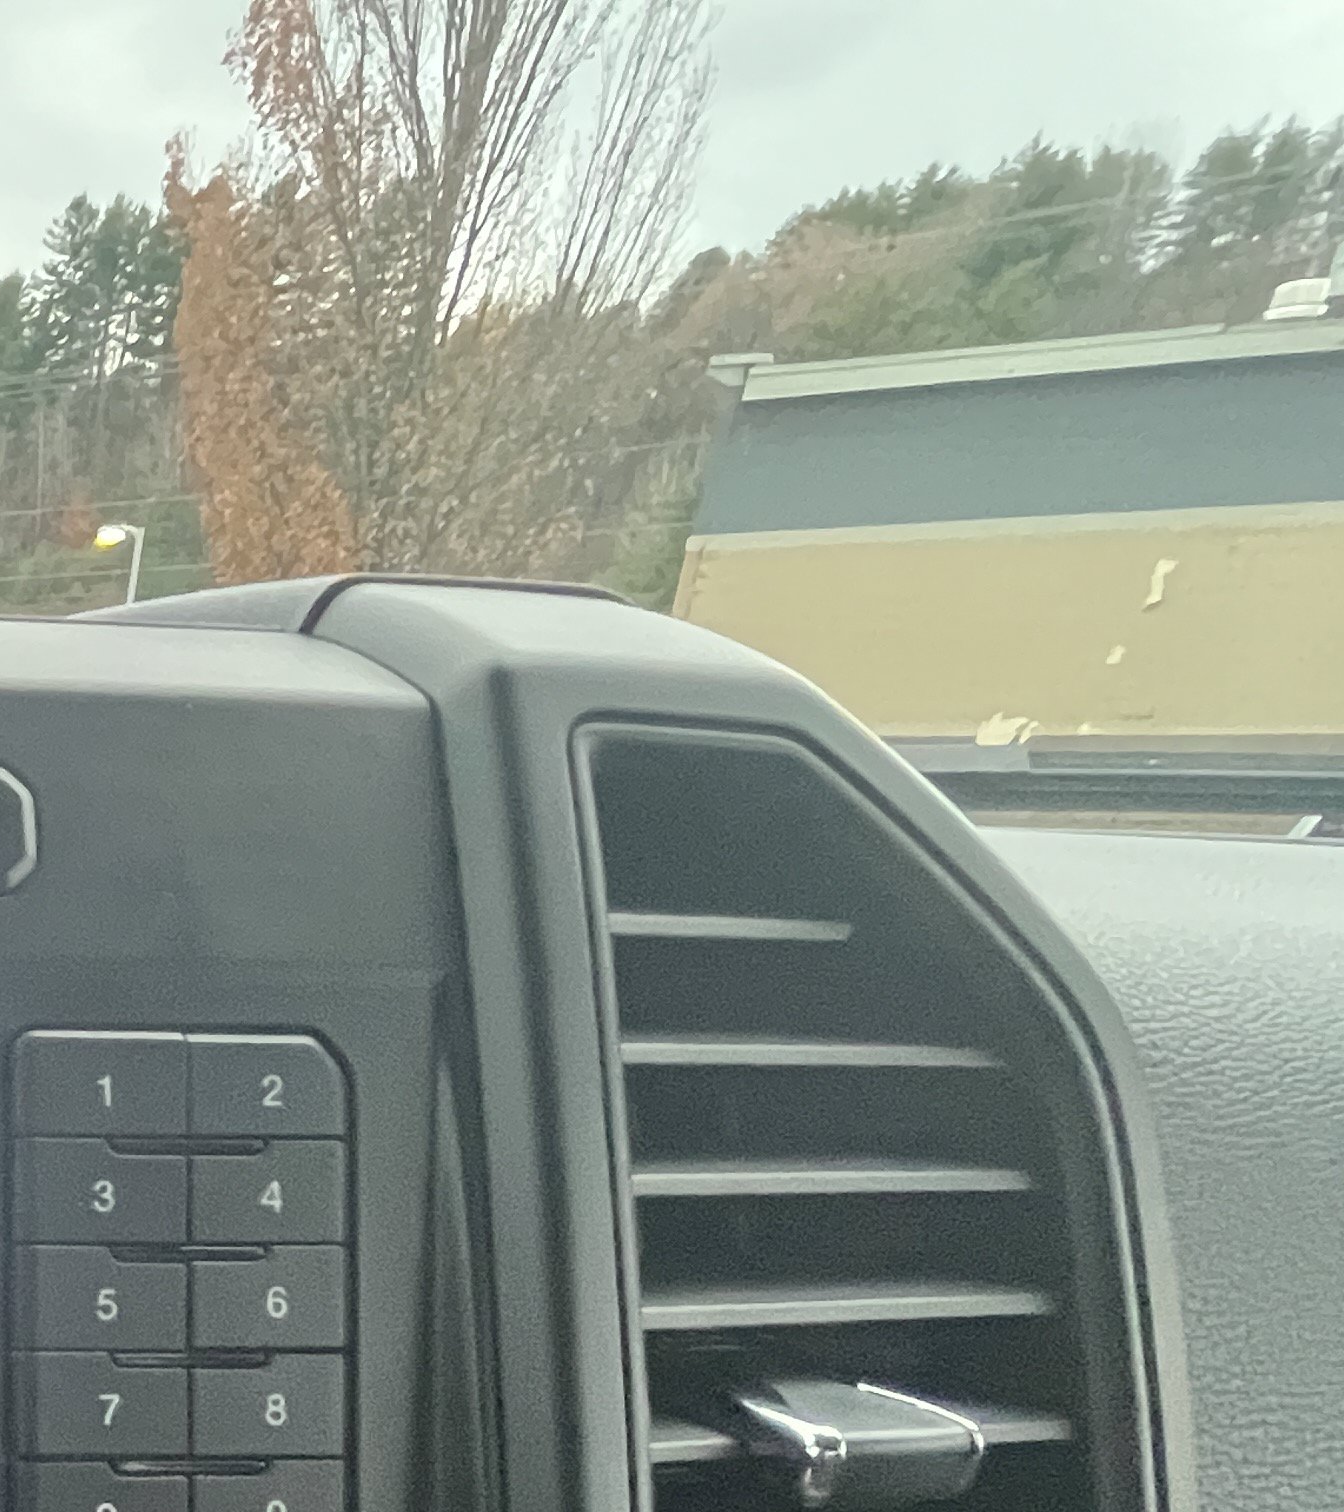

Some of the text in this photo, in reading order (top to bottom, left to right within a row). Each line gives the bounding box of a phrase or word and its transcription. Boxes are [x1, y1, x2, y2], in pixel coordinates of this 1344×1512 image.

[96, 1075, 112, 1107] 1
[261, 1074, 283, 1107] 2
[93, 1179, 116, 1213] 3
[260, 1180, 283, 1213] 4
[96, 1288, 118, 1321] 5
[266, 1285, 289, 1319] 6
[99, 1393, 121, 1426] 7
[264, 1393, 288, 1427] 8
